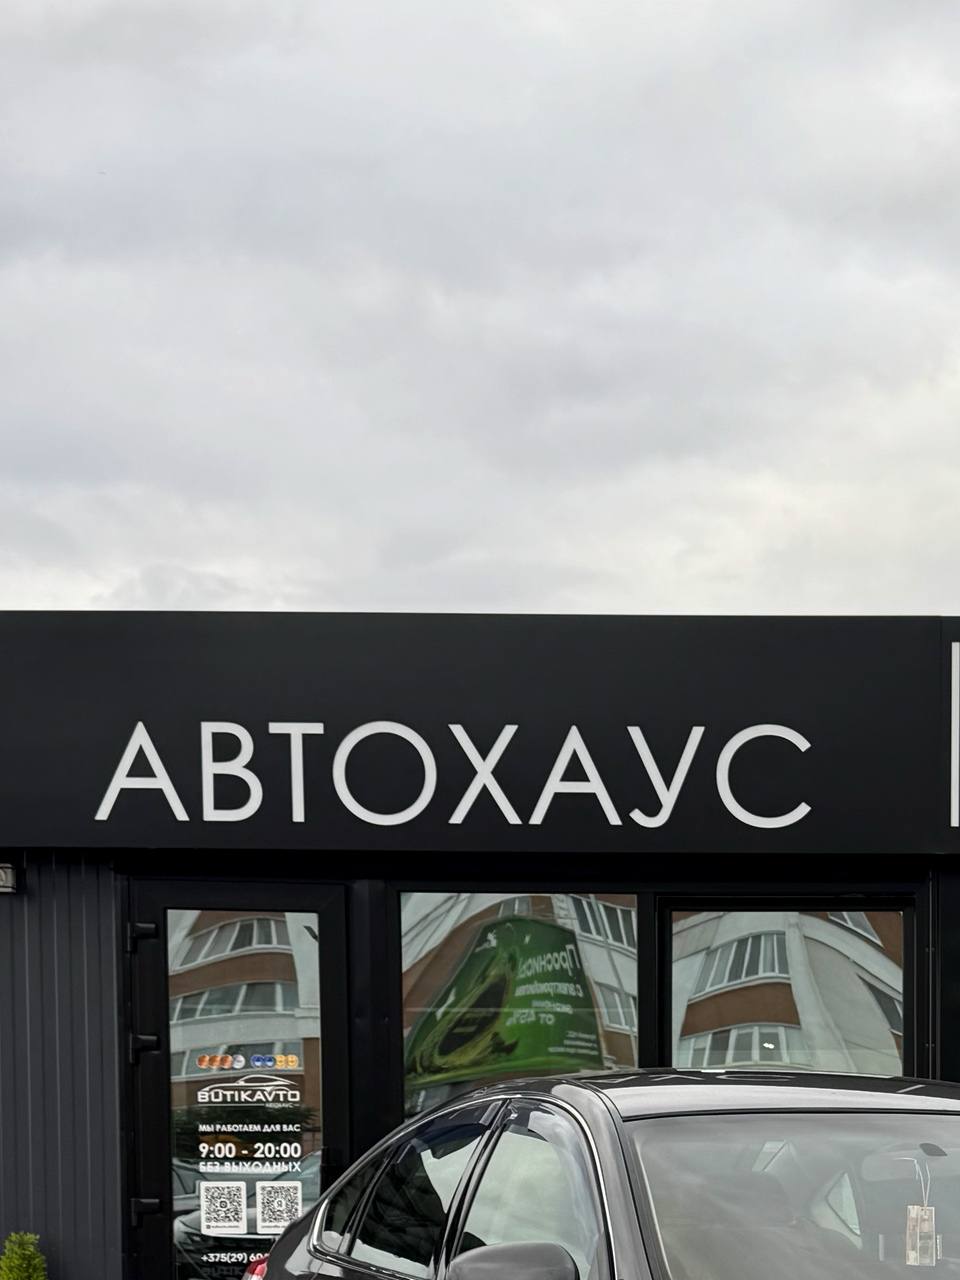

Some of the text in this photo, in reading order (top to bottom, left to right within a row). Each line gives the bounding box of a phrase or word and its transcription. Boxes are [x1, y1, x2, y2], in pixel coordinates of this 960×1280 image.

[94, 720, 813, 830] АВТОХАУС
[197, 1089, 300, 1103] BUTIKAVTO
[198, 1124, 301, 1132] МЫ РАБОТАЕМ ДЛЯ ВАС
[199, 1143, 236, 1158] 9:00
[253, 1142, 301, 1158] 20:00
[224, 1161, 301, 1173] ВЫХОДНЫХ
[200, 1252, 248, 1264] +375(29)
